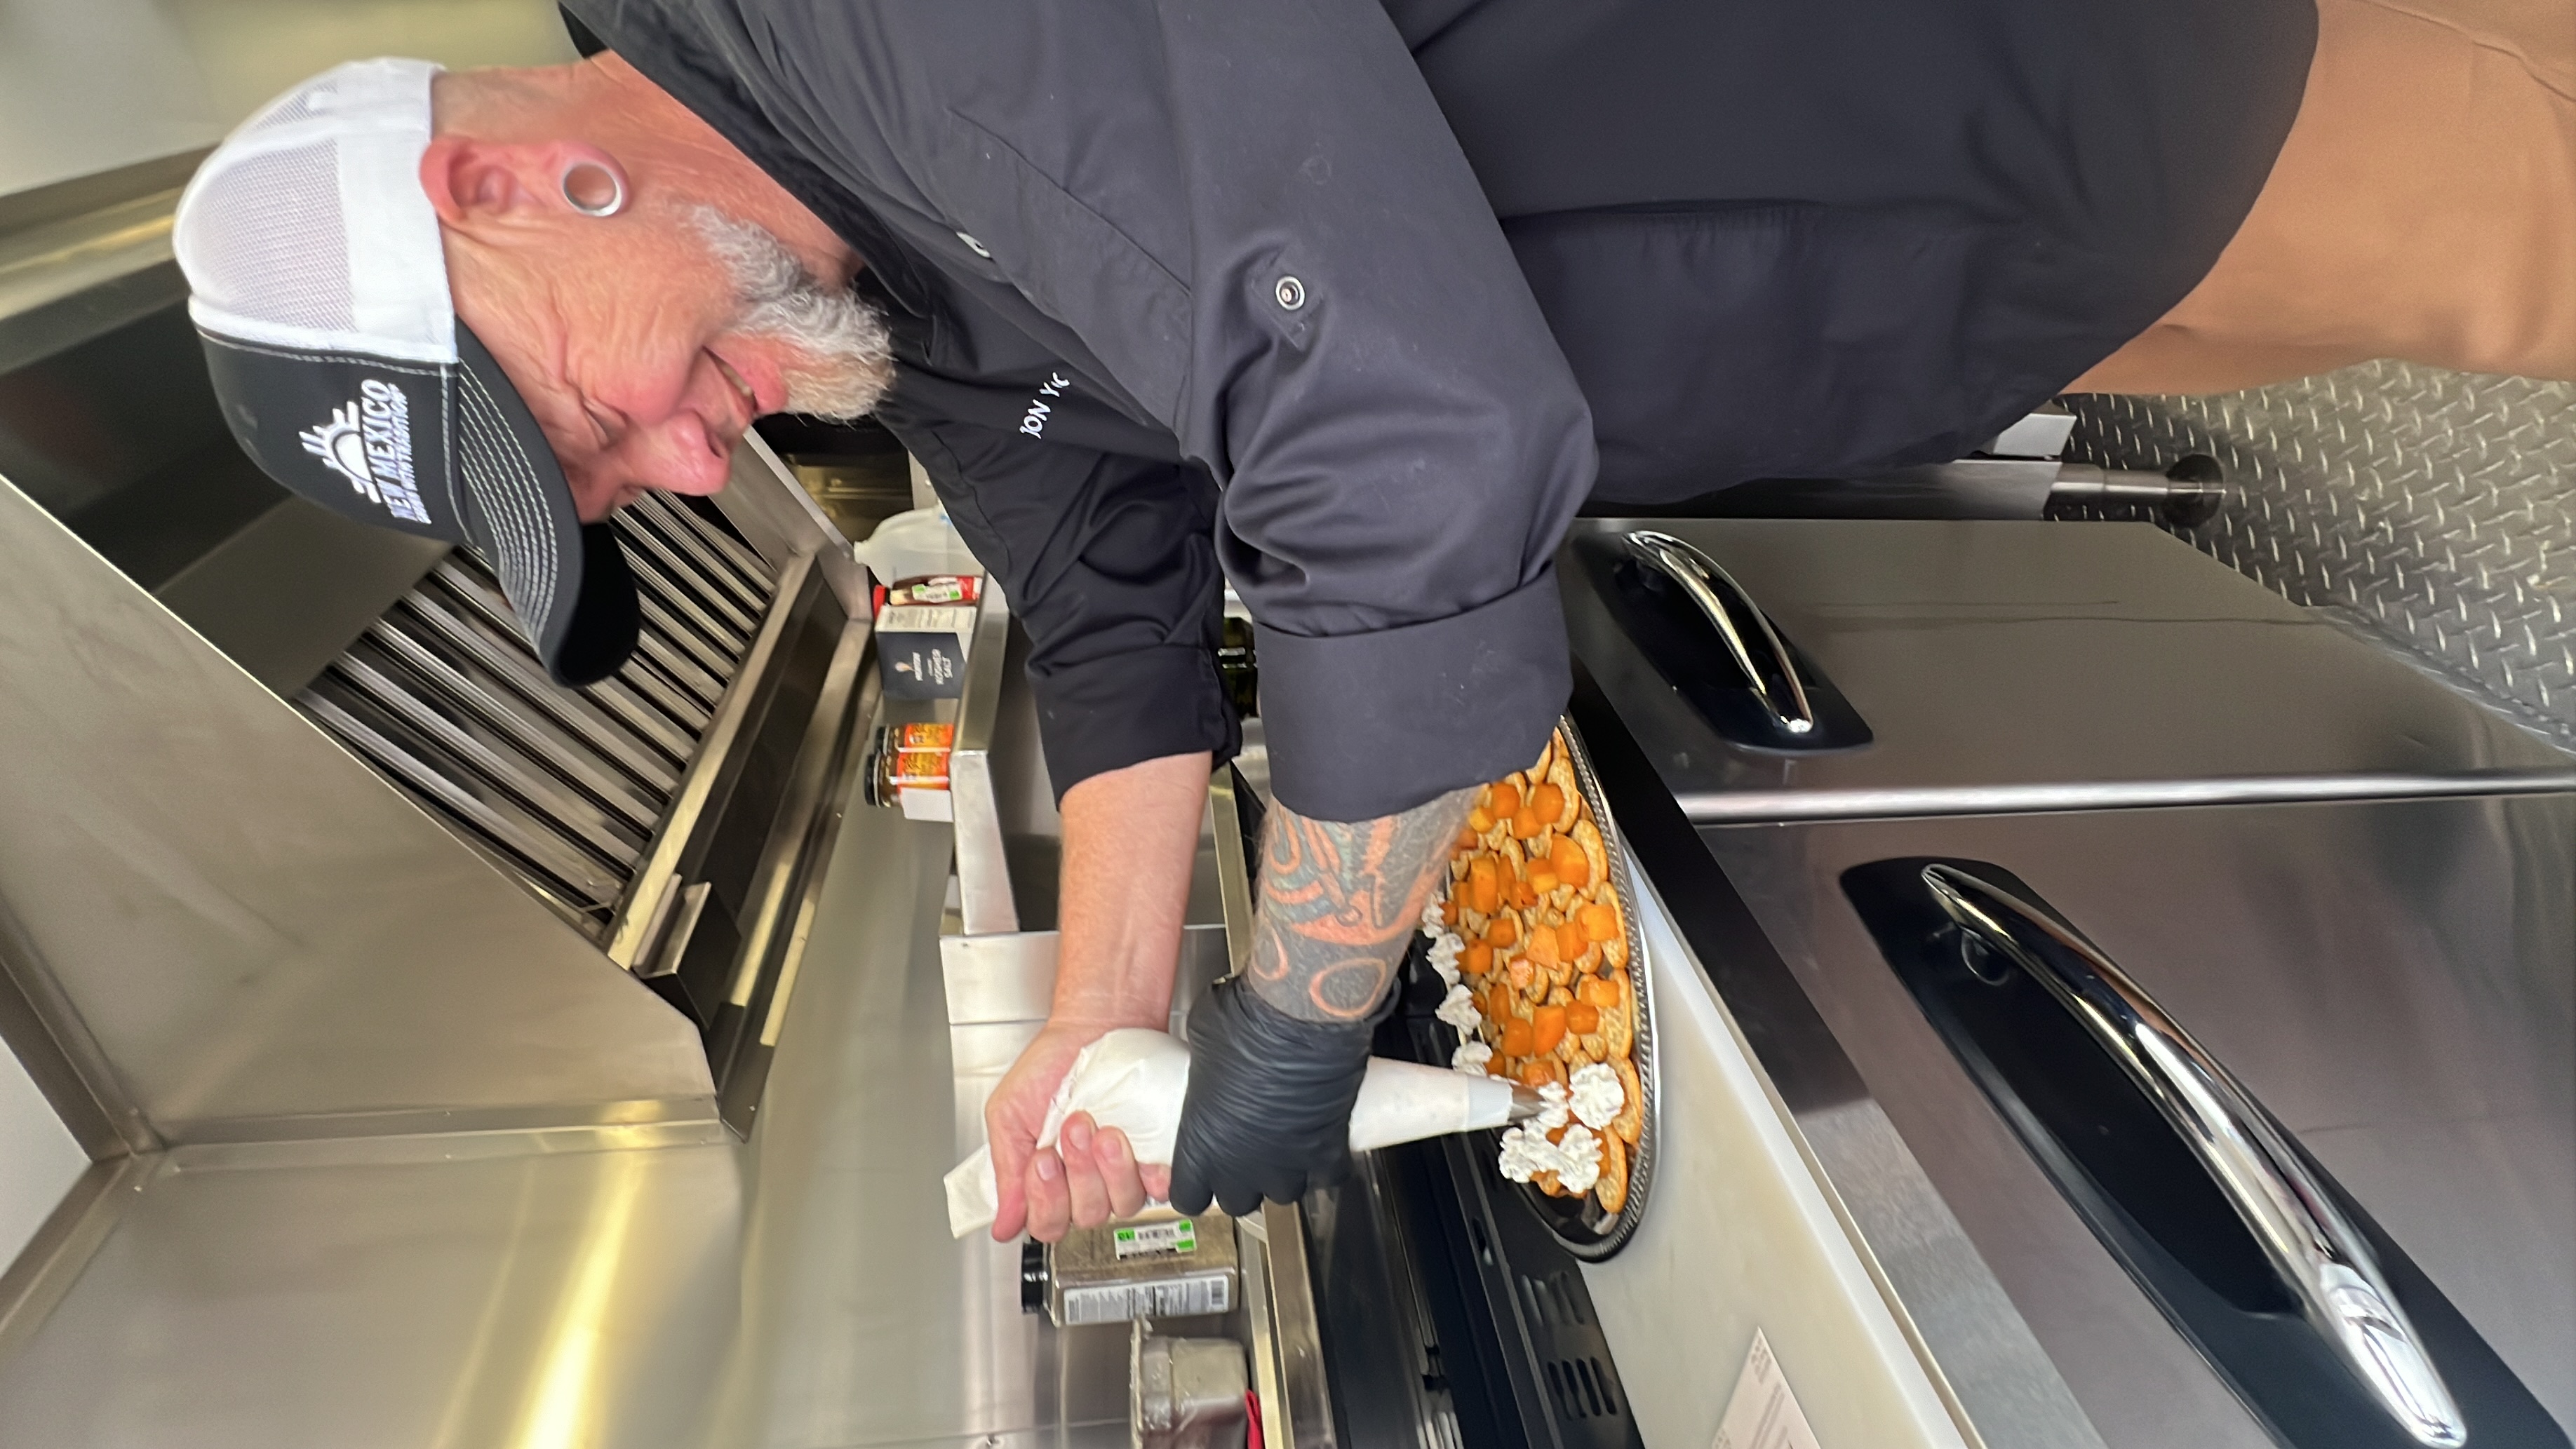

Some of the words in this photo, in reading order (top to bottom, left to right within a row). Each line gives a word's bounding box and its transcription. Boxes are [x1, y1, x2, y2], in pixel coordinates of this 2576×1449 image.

[361, 378, 402, 480] MEXICO
[1019, 398, 1051, 439] JON
[375, 476, 415, 518] NEW
